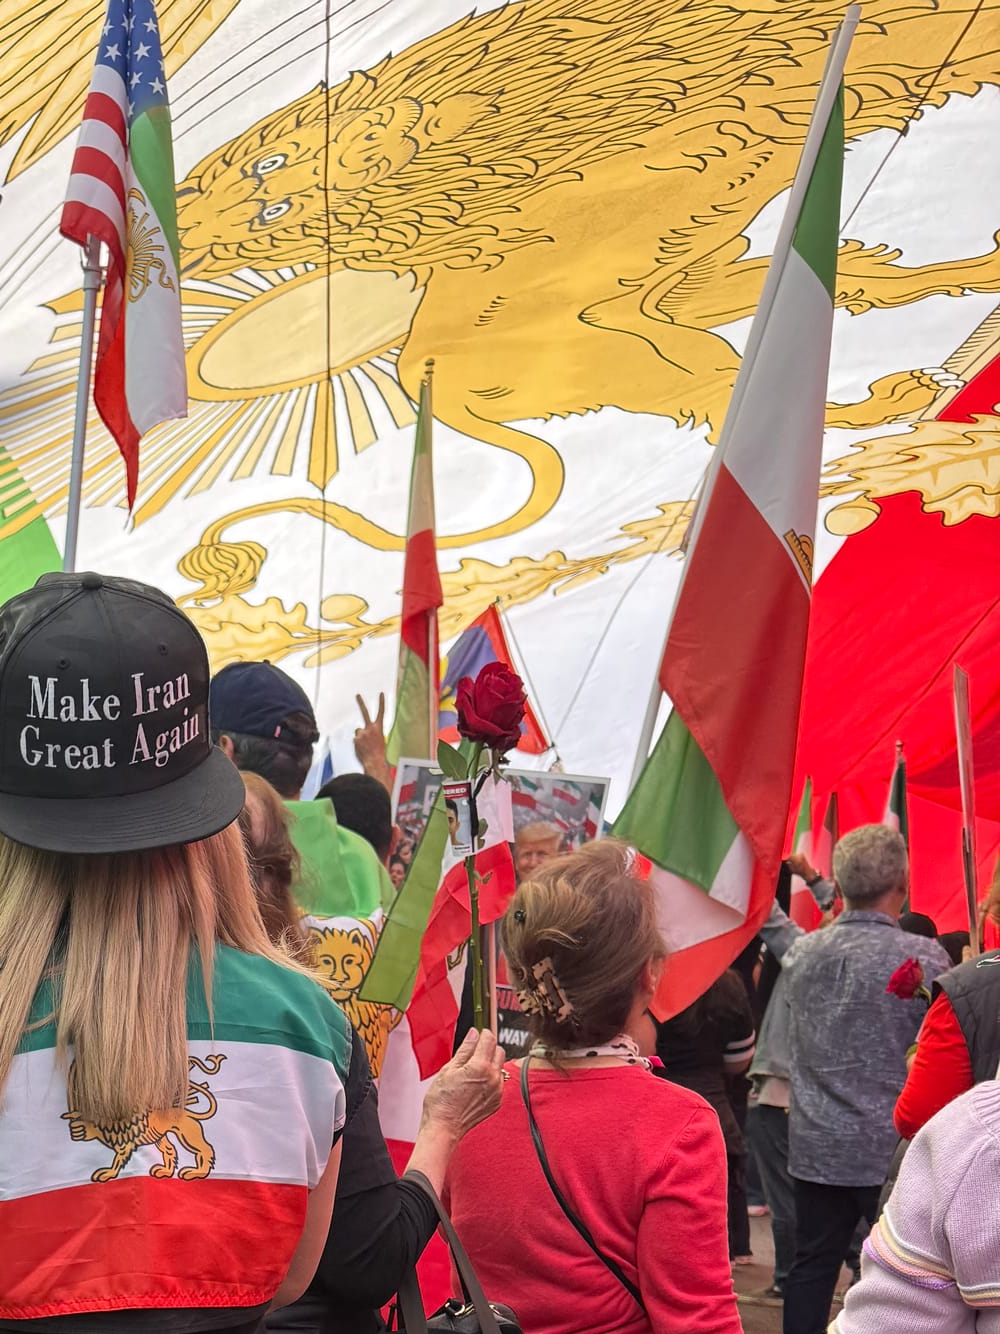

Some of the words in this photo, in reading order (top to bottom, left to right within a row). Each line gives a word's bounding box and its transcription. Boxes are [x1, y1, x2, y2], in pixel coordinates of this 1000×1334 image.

[26, 675, 120, 722] Make
[131, 672, 191, 717] Iran
[20, 724, 116, 769] Great
[129, 707, 200, 767] Again
[498, 1027, 529, 1047] WAY
